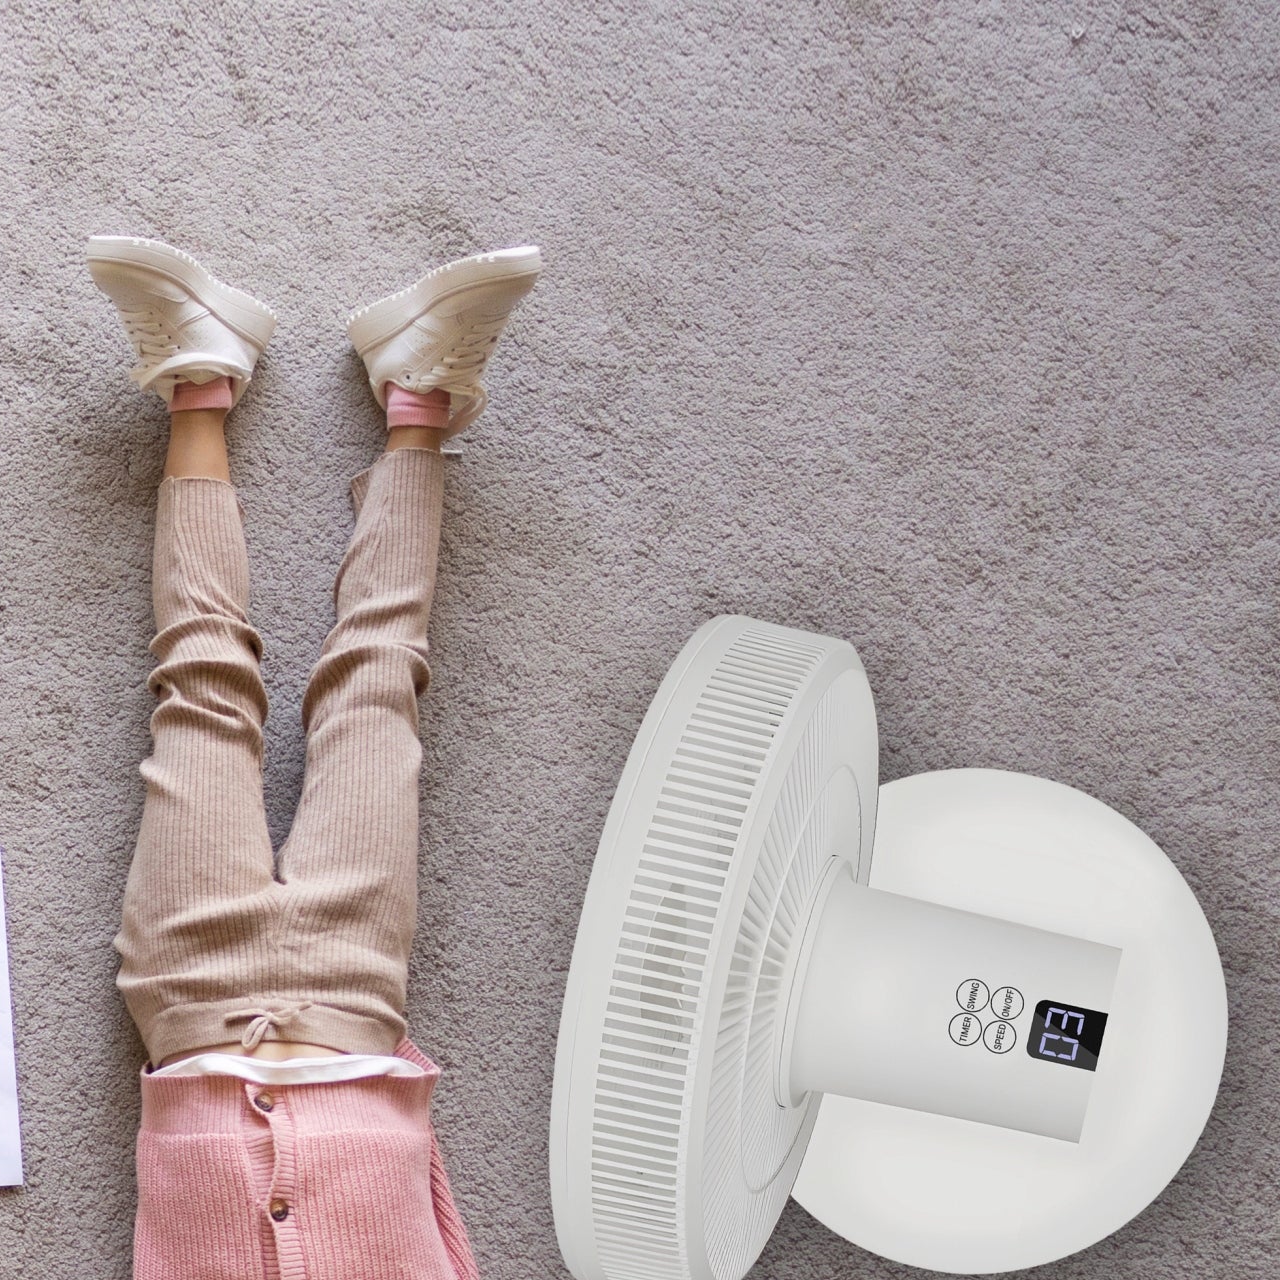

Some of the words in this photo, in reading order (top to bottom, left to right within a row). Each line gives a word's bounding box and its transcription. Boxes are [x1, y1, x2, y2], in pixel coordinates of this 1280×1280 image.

[966, 982, 980, 1010] SWING
[1001, 988, 1015, 1018] ON/OFF
[959, 1016, 972, 1042] TIMER
[993, 1024, 1007, 1050] SPEED
